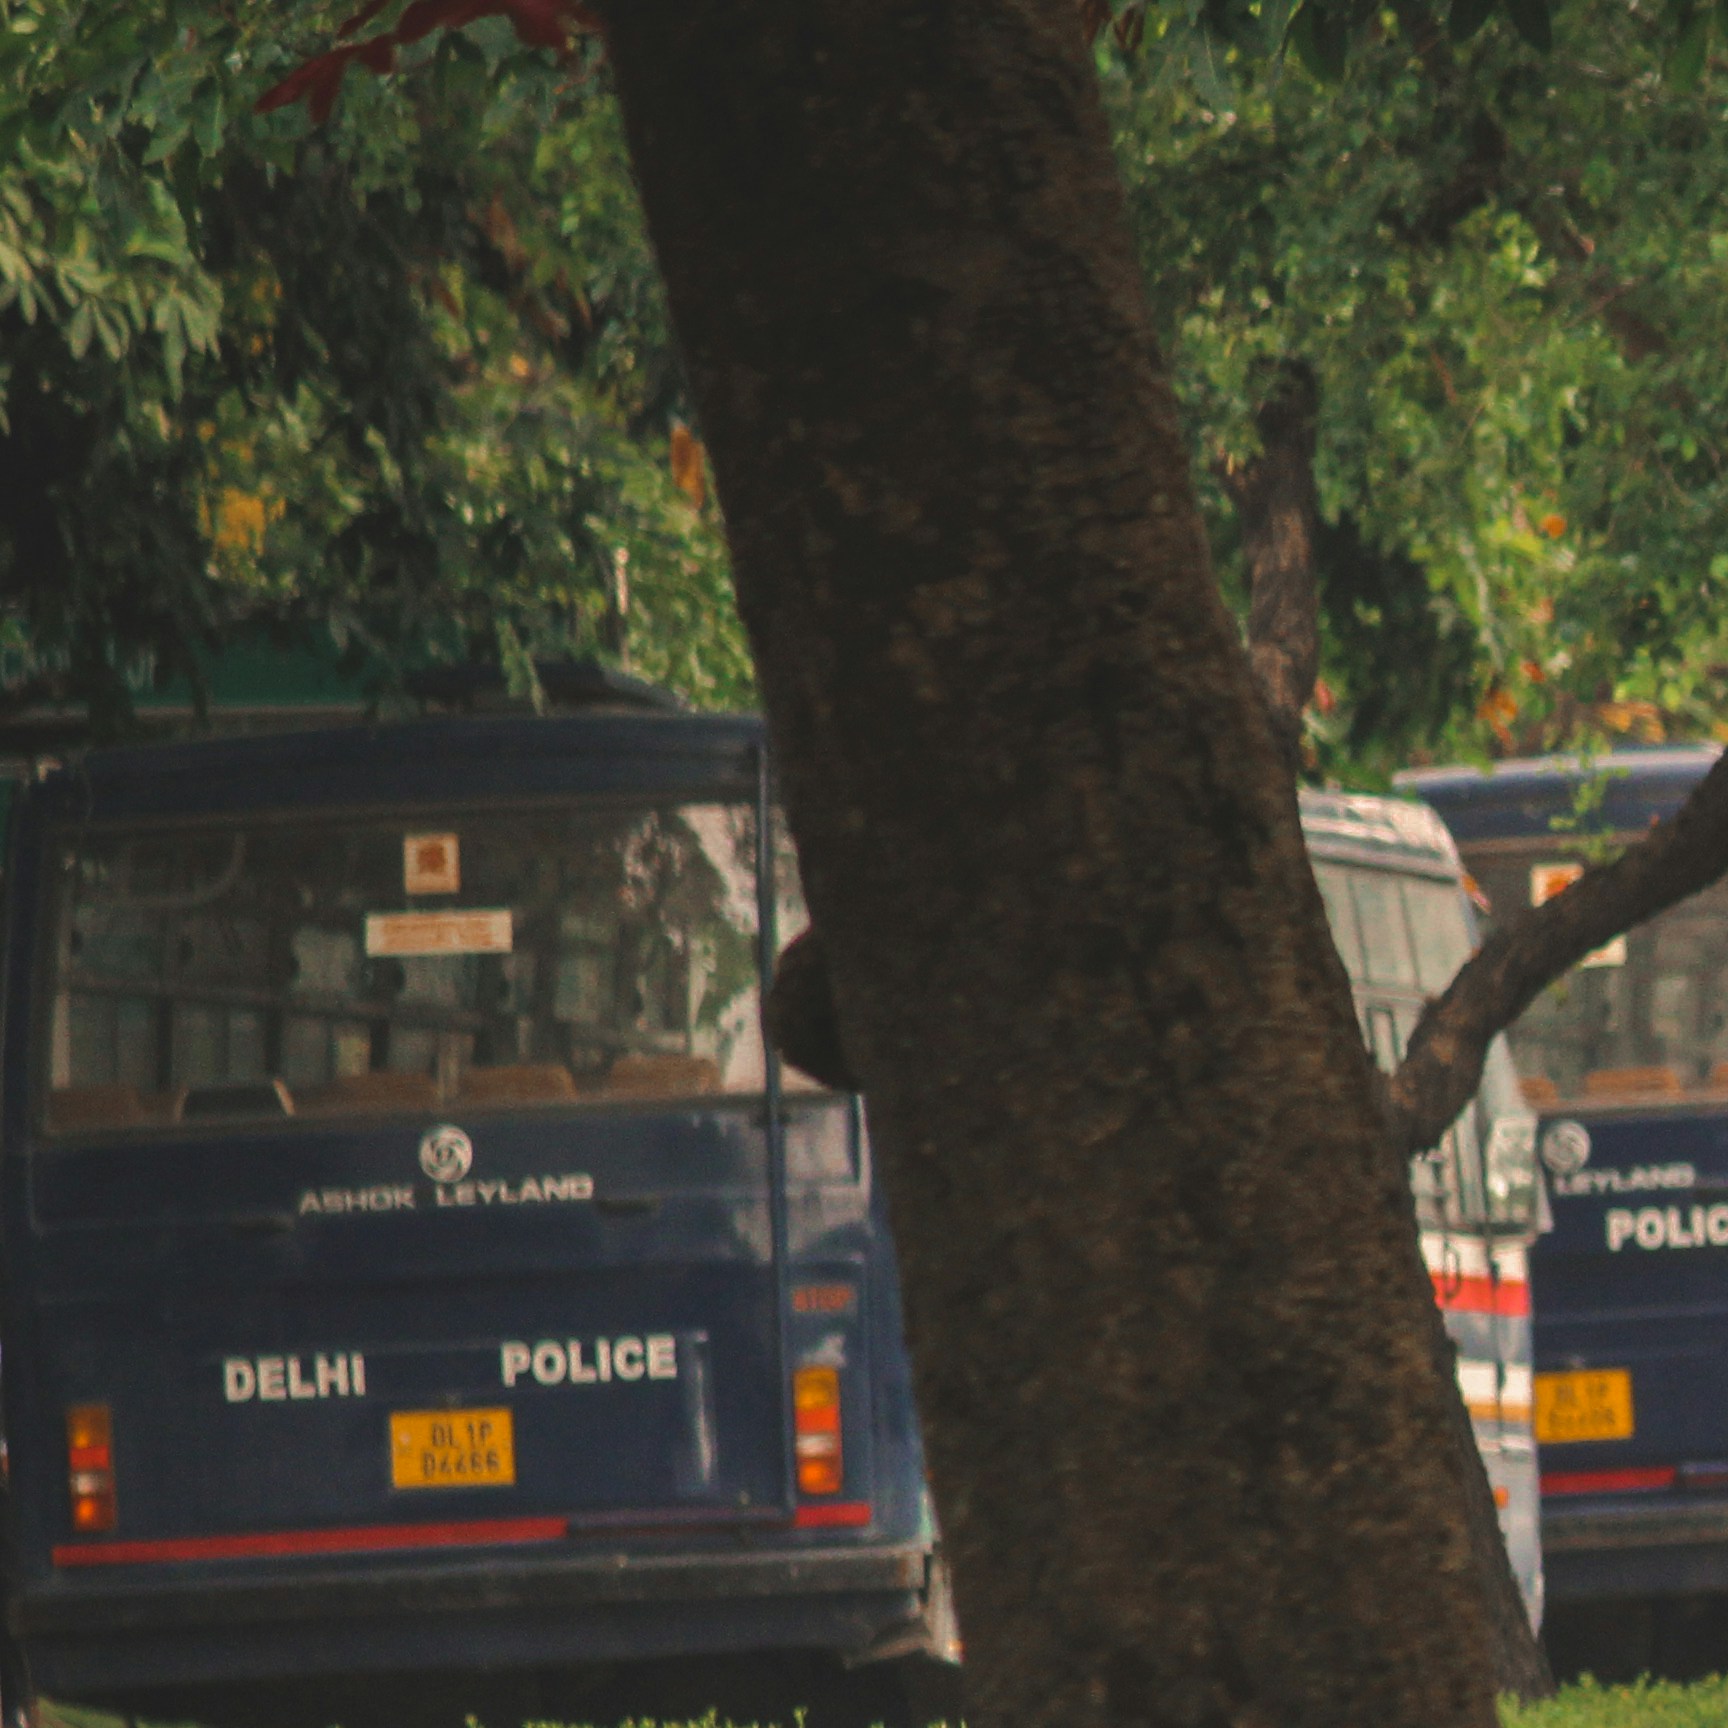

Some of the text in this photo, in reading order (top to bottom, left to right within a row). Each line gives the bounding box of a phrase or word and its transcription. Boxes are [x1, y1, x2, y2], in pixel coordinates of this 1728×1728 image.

[300, 1174, 594, 1215] ASHOK LEYLAND
[223, 1334, 678, 1402] DELHI POLICE
